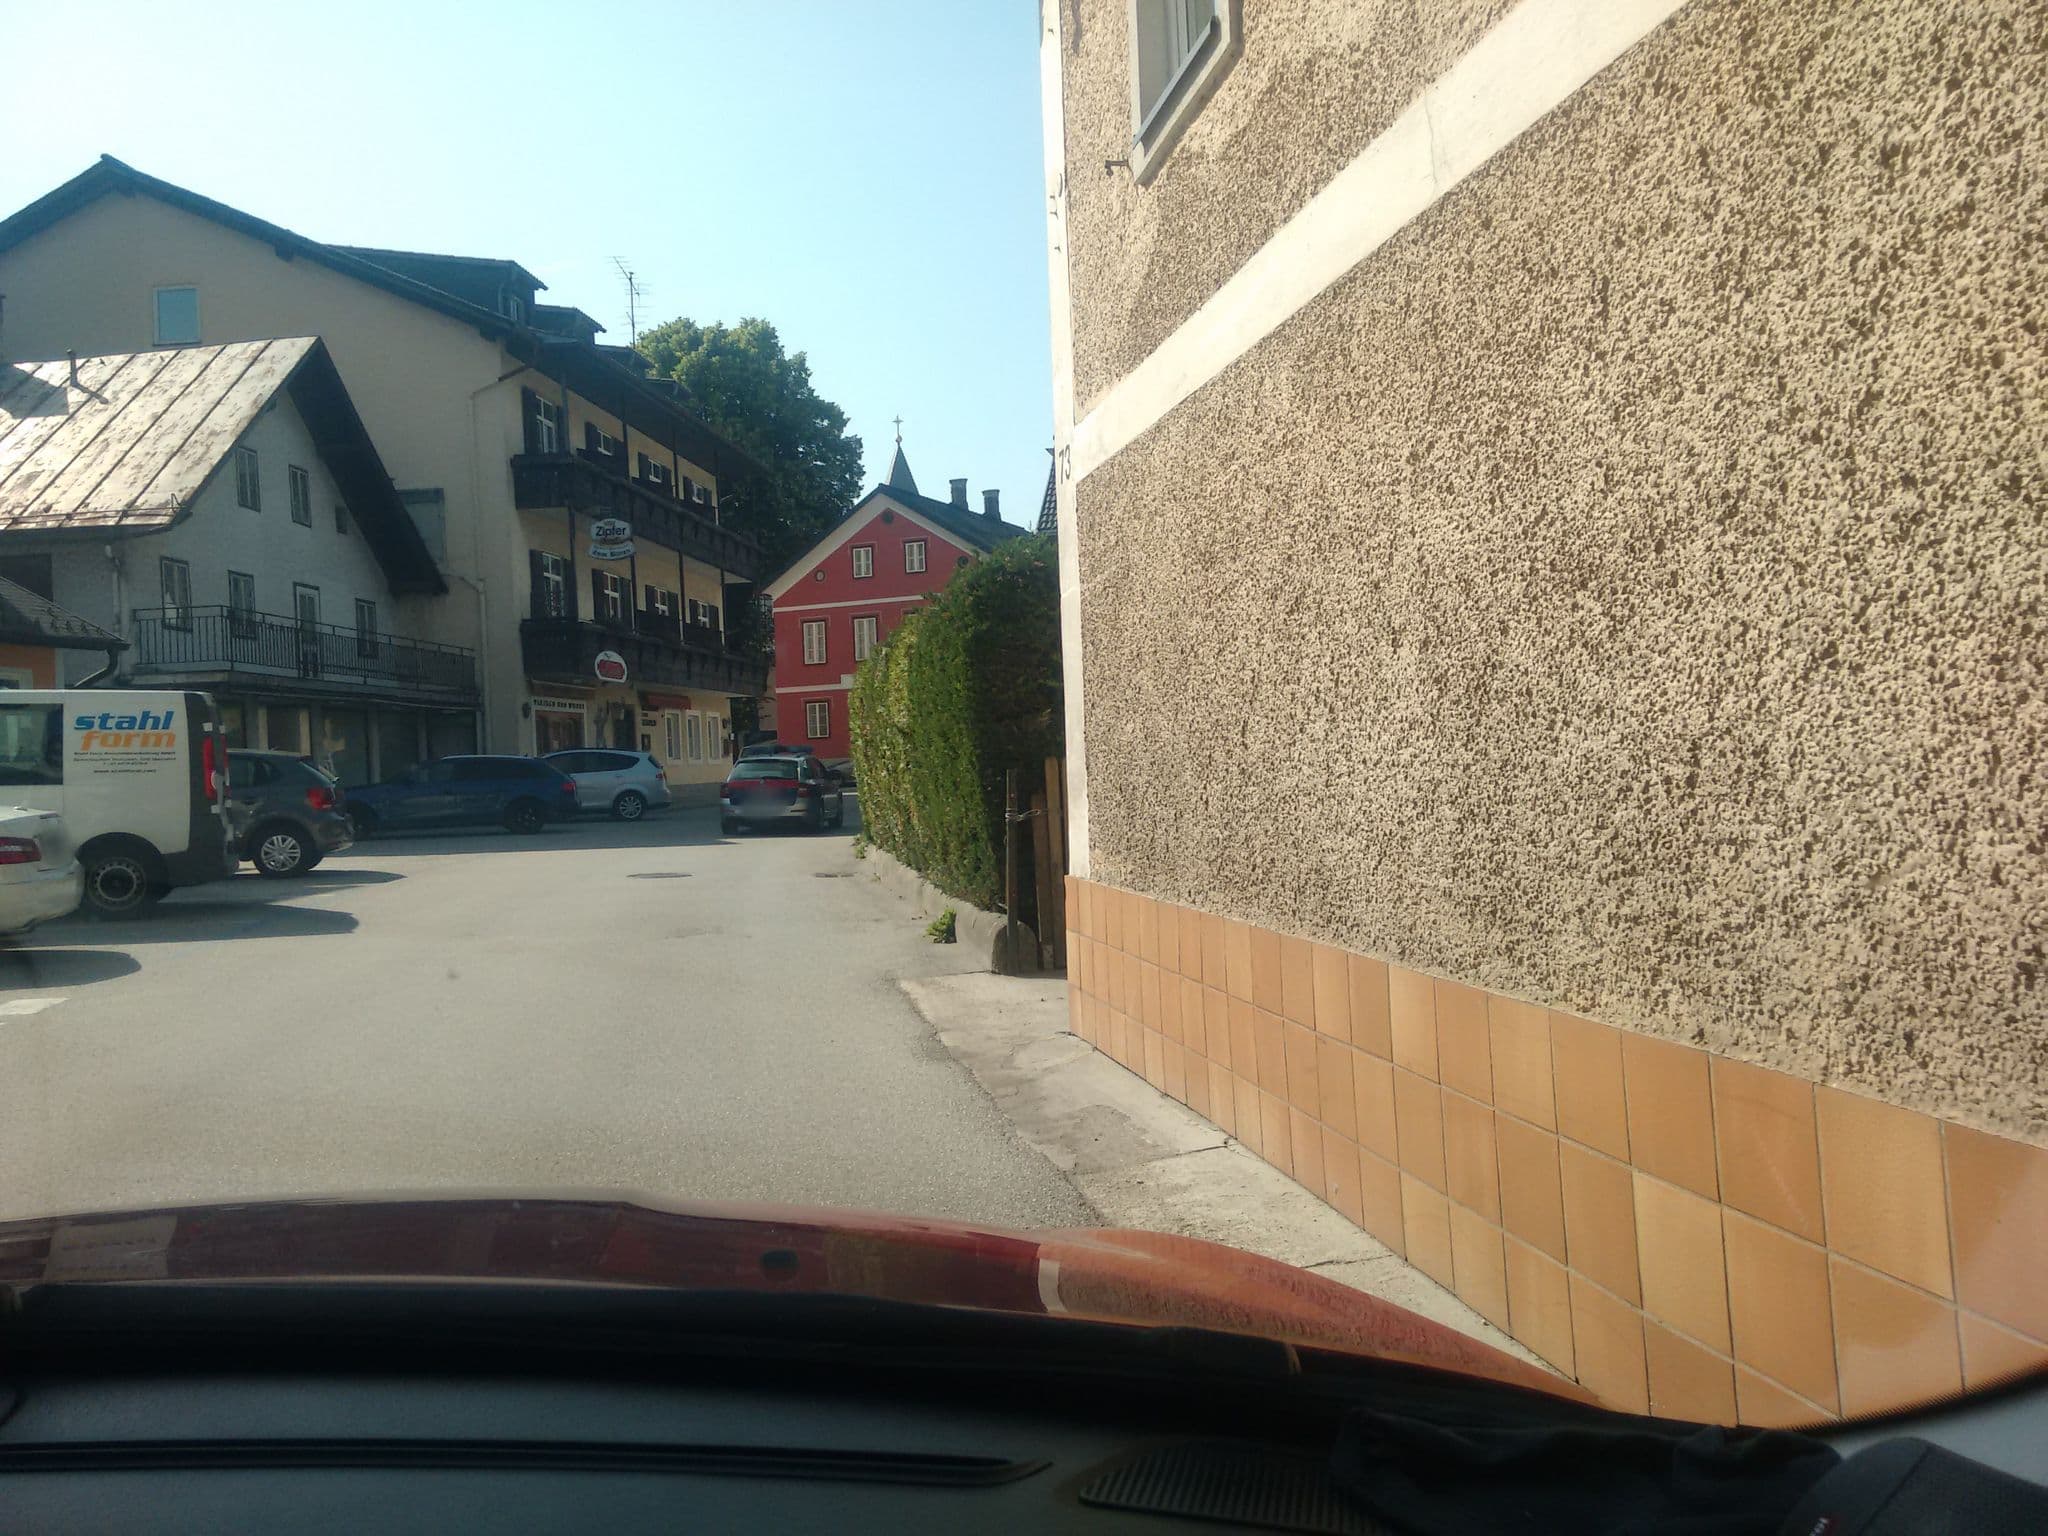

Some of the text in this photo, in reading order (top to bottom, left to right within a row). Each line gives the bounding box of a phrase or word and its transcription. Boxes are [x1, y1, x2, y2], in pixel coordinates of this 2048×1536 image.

[595, 524, 626, 538] Zipfer
[73, 710, 175, 730] stahl
[80, 730, 177, 751] form
